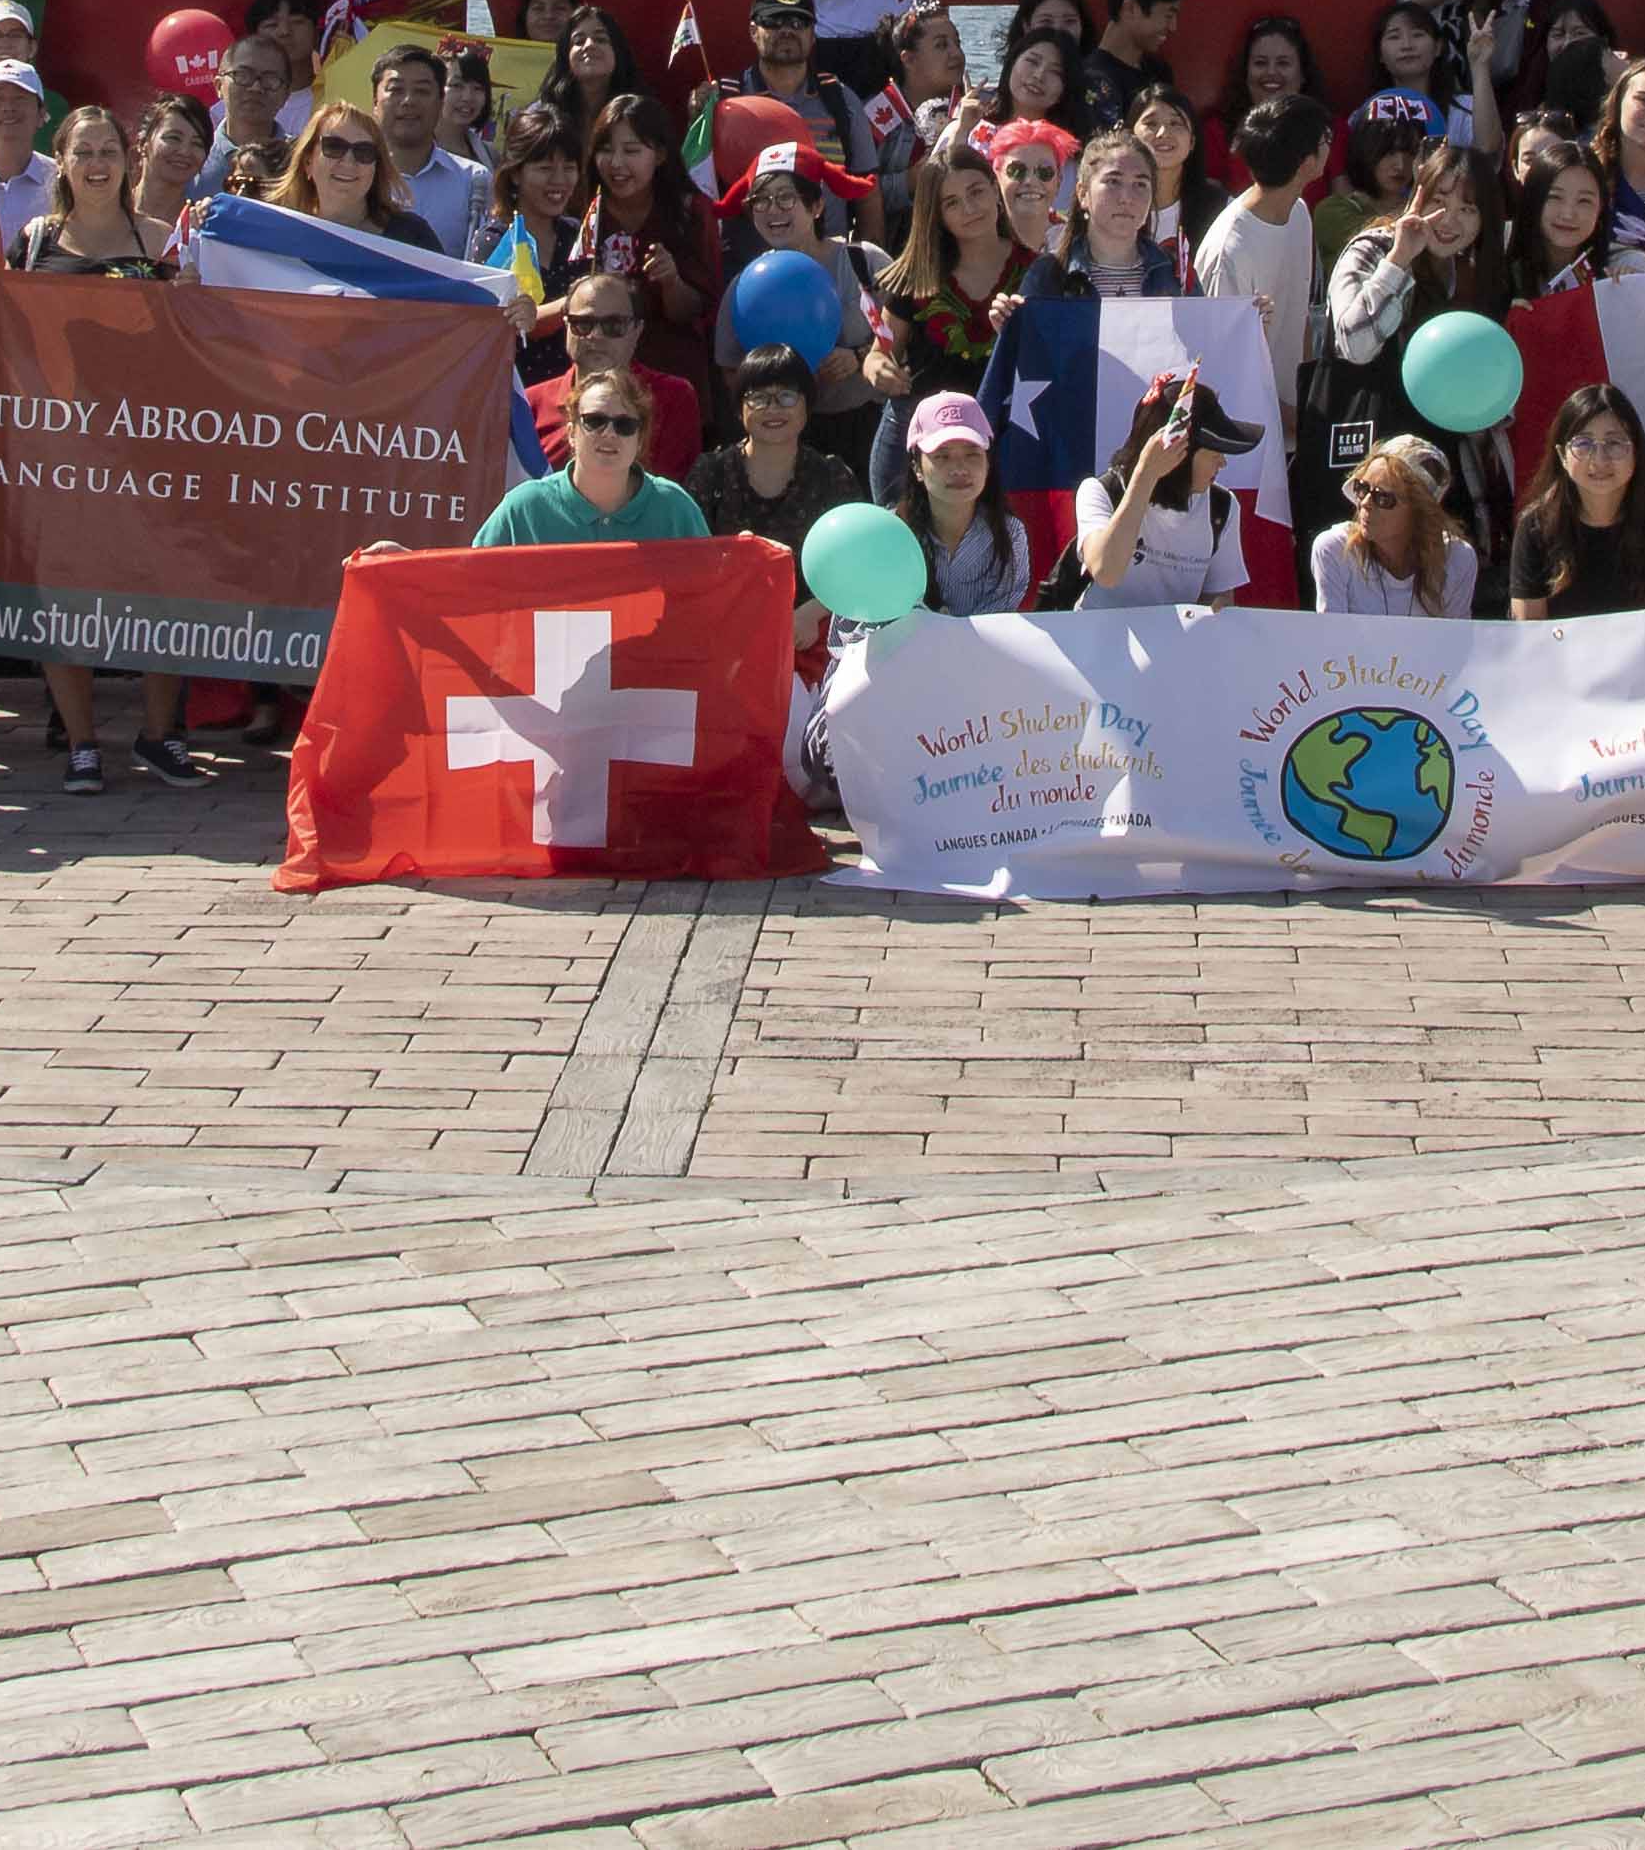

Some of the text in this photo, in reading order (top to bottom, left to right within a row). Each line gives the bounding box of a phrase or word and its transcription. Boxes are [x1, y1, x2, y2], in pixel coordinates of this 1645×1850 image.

[105, 397, 282, 448] ABROAD
[295, 412, 469, 464] CANADA
[1339, 433, 1365, 444] KEEP
[228, 472, 467, 523] INSTITUTE
[917, 701, 1152, 758] World Student Day
[1239, 655, 1493, 752] World Student Day
[913, 742, 1164, 806] Journée des étudiants
[991, 774, 1098, 814] du monde
[935, 834, 988, 853] LANGUES
[990, 827, 1038, 846] CANADA
[1109, 813, 1152, 828] CANADA
